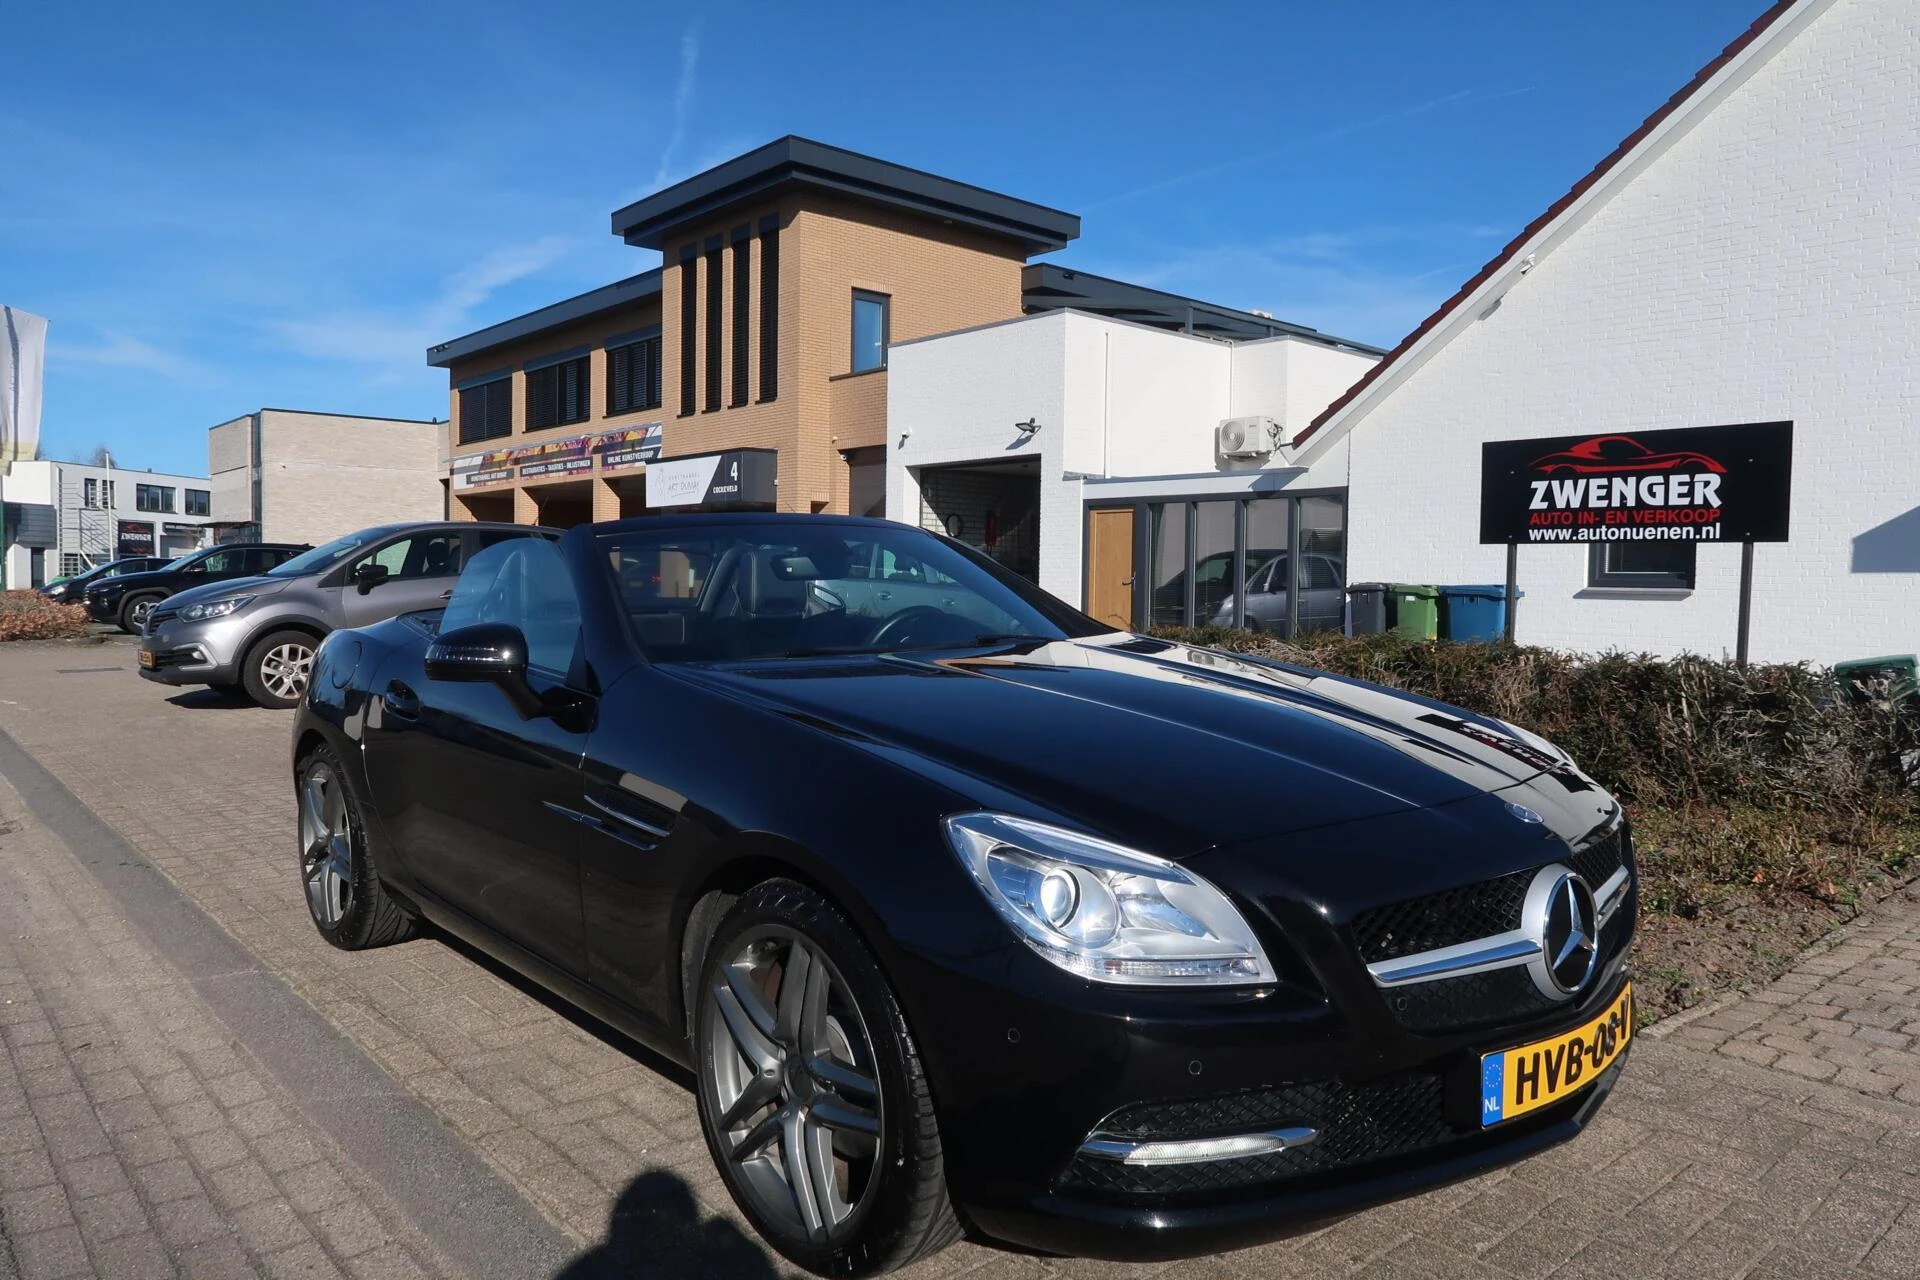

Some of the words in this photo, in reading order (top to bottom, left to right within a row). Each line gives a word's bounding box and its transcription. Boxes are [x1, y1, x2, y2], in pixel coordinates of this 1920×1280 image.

[730, 461, 738, 481] 4
[1528, 473, 1722, 510] ZWENGER
[1529, 511, 1573, 525] AUTO
[1578, 511, 1600, 525] IN-
[1605, 510, 1628, 524] EN
[1633, 509, 1721, 524] VERKOOP
[1528, 522, 1721, 541] www.autonuenen.nl
[1484, 1095, 1500, 1114] NL
